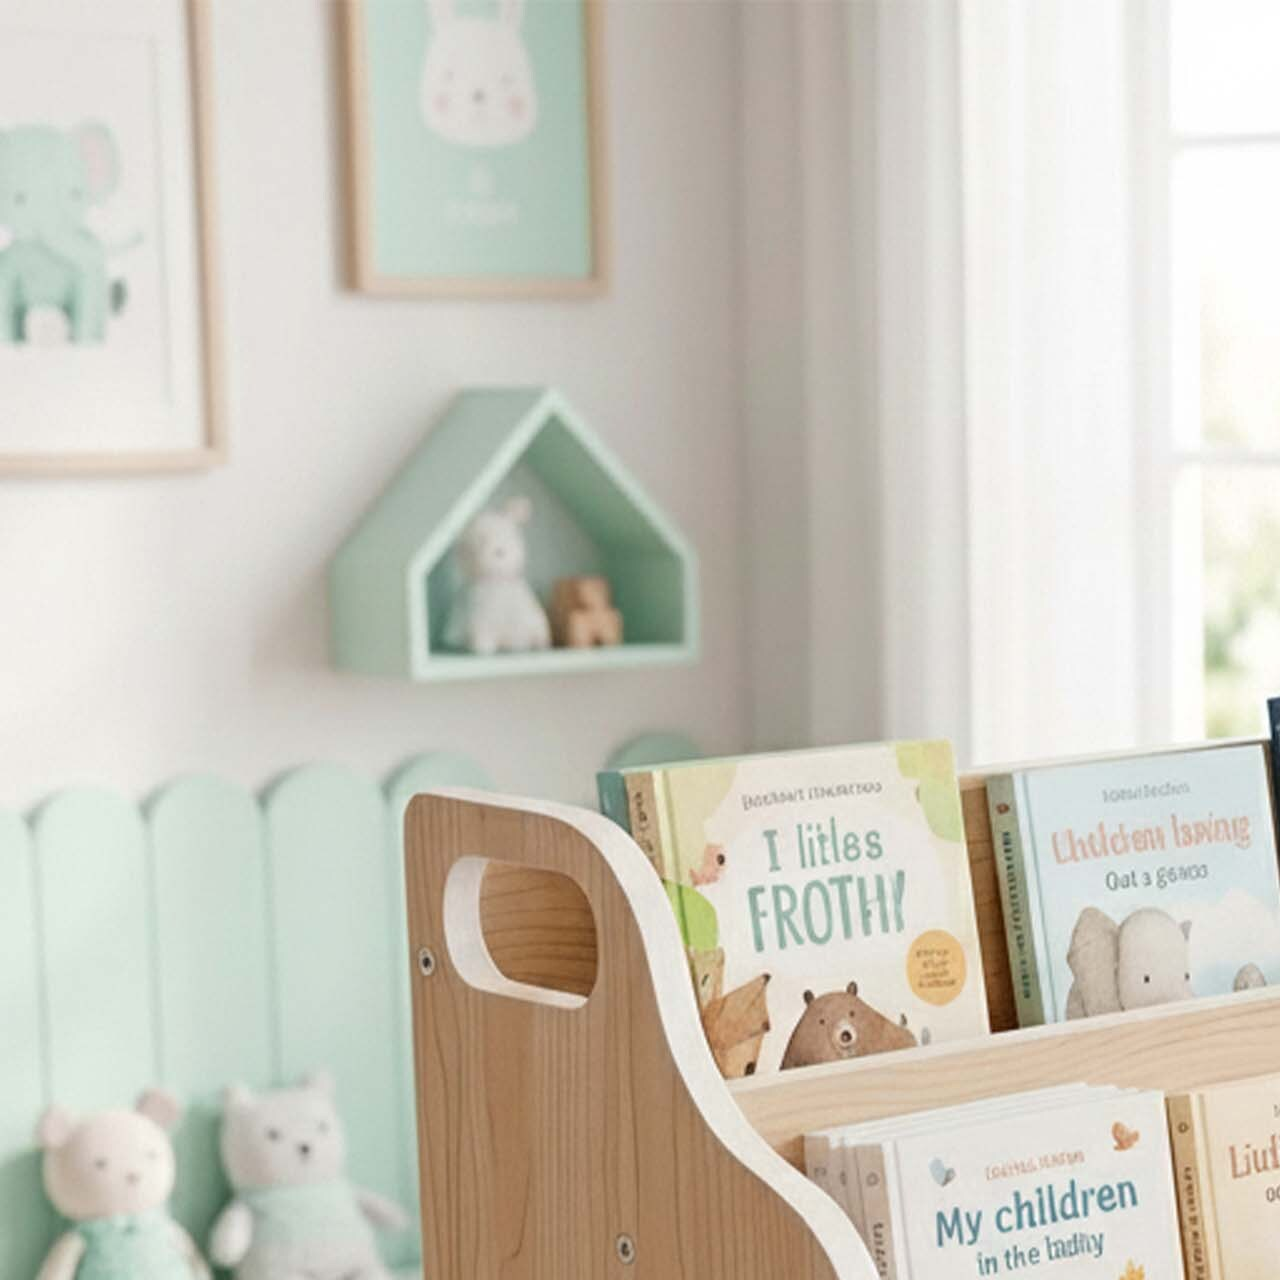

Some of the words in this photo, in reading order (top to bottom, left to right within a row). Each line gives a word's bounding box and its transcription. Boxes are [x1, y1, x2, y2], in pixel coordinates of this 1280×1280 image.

[763, 829, 781, 872] I
[936, 1206, 982, 1248] My
[994, 1178, 1138, 1234] children
[977, 1252, 998, 1276] in
[1005, 1244, 1040, 1271] the
